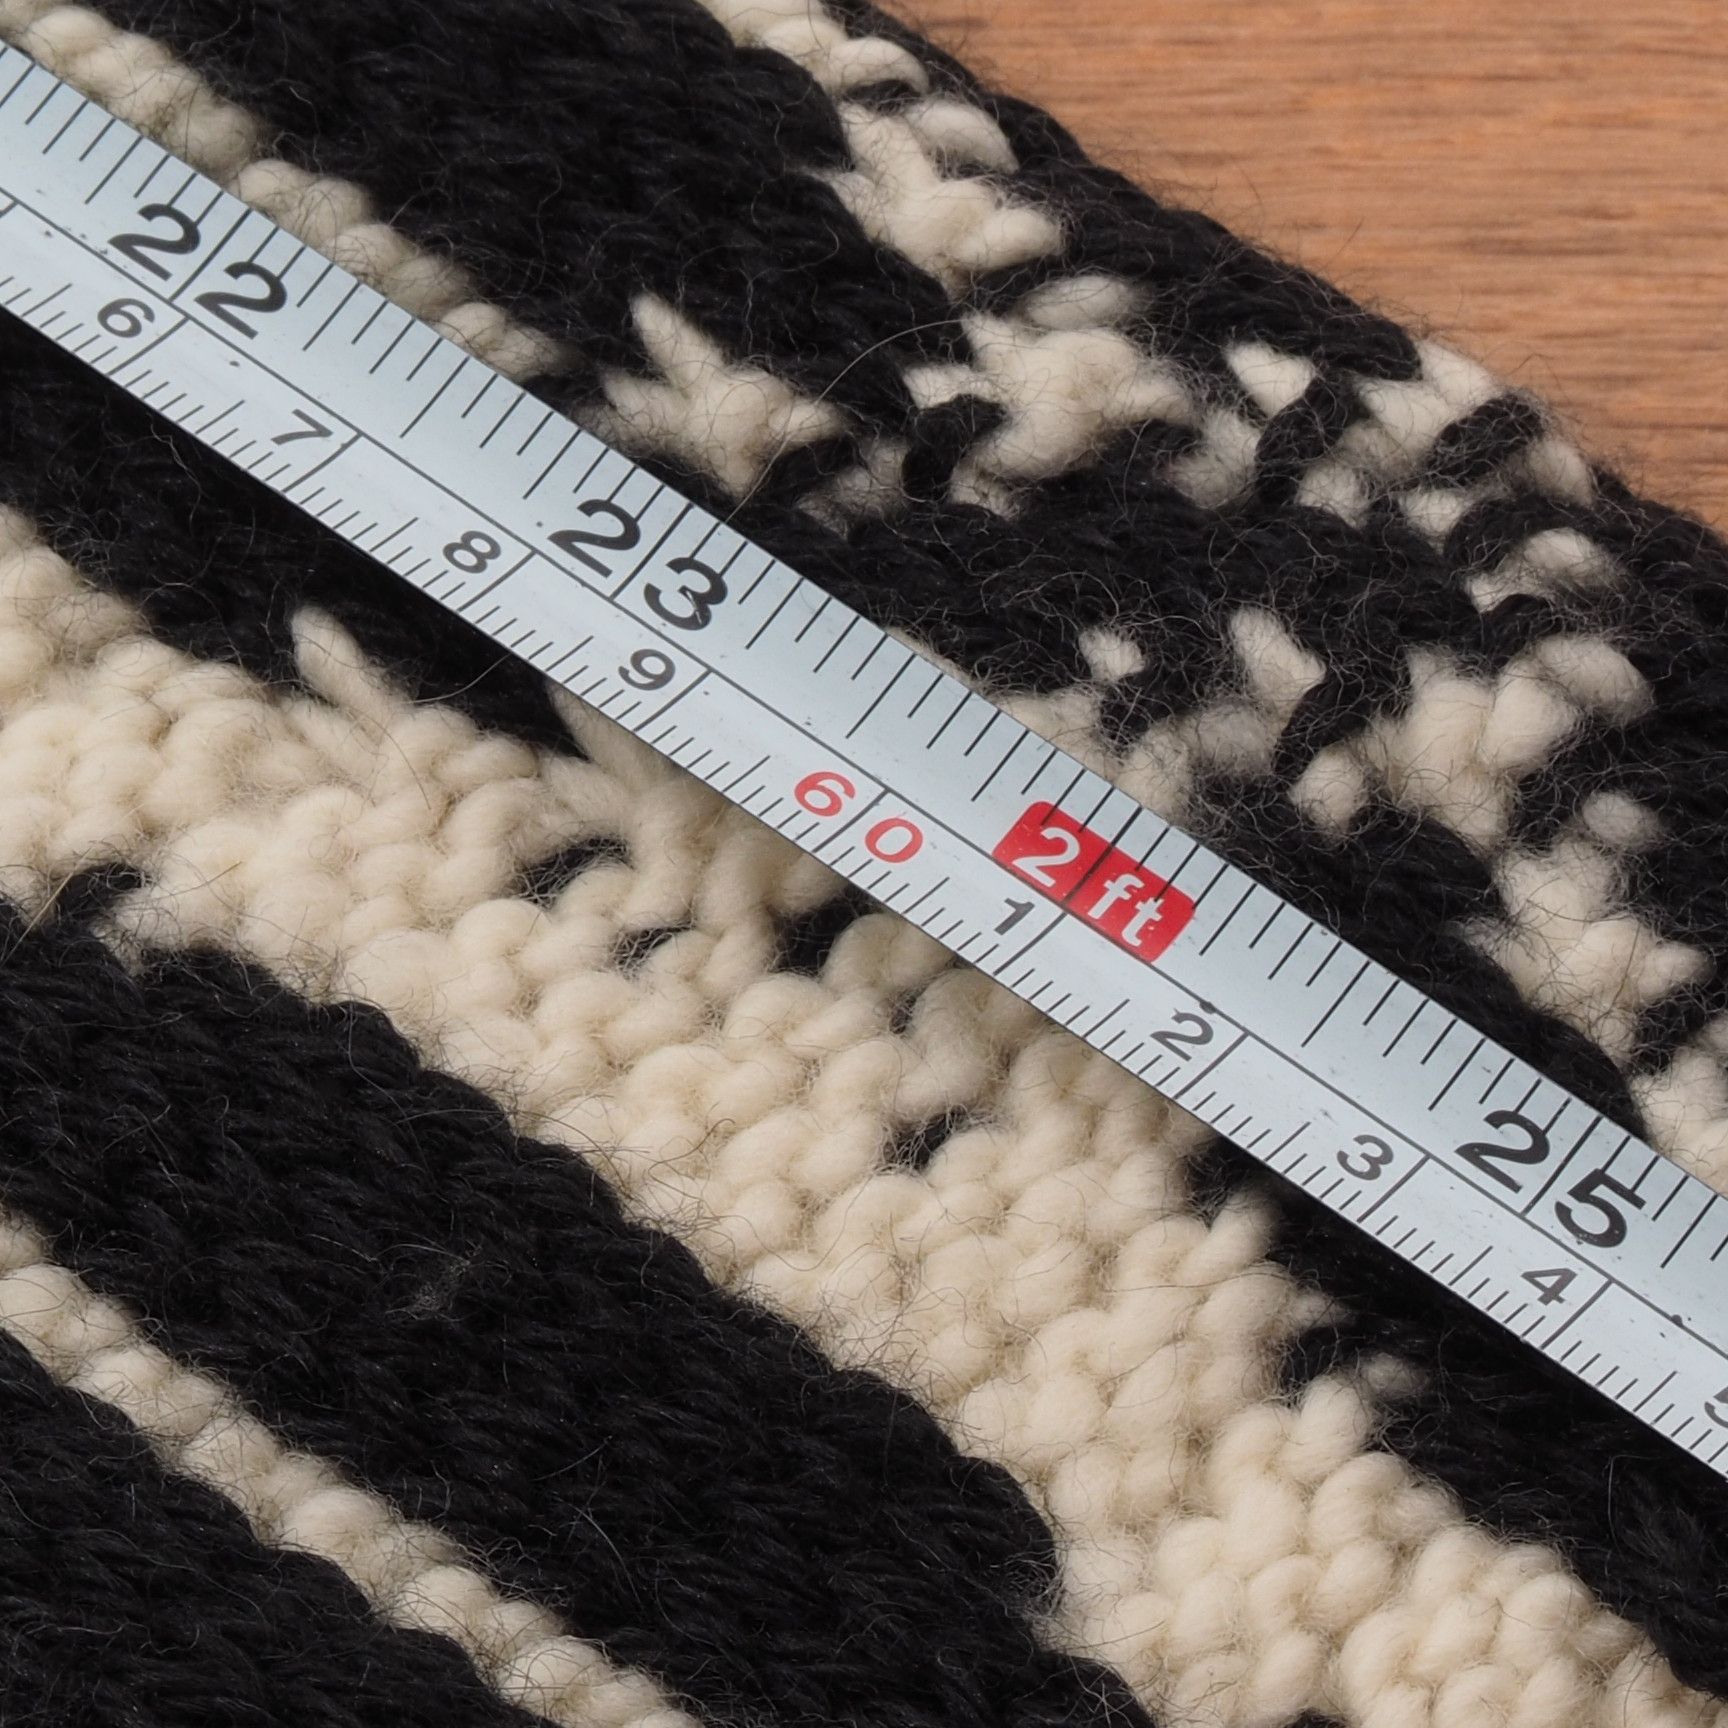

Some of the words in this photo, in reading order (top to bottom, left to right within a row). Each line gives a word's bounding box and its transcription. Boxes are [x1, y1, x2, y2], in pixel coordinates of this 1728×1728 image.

[108, 203, 287, 340] 22
[97, 297, 155, 339] 6
[271, 410, 332, 448] 7
[442, 530, 501, 574] 8
[547, 498, 729, 632] 23
[617, 647, 676, 692] 9
[793, 771, 923, 863] 60
[1013, 826, 1081, 887] 2
[1086, 871, 1164, 948] ft
[993, 898, 1037, 934] 1
[1151, 1010, 1214, 1061] 2
[1336, 1133, 1394, 1181] 3
[1456, 1109, 1647, 1249] 25
[1520, 1266, 1579, 1306] 4
